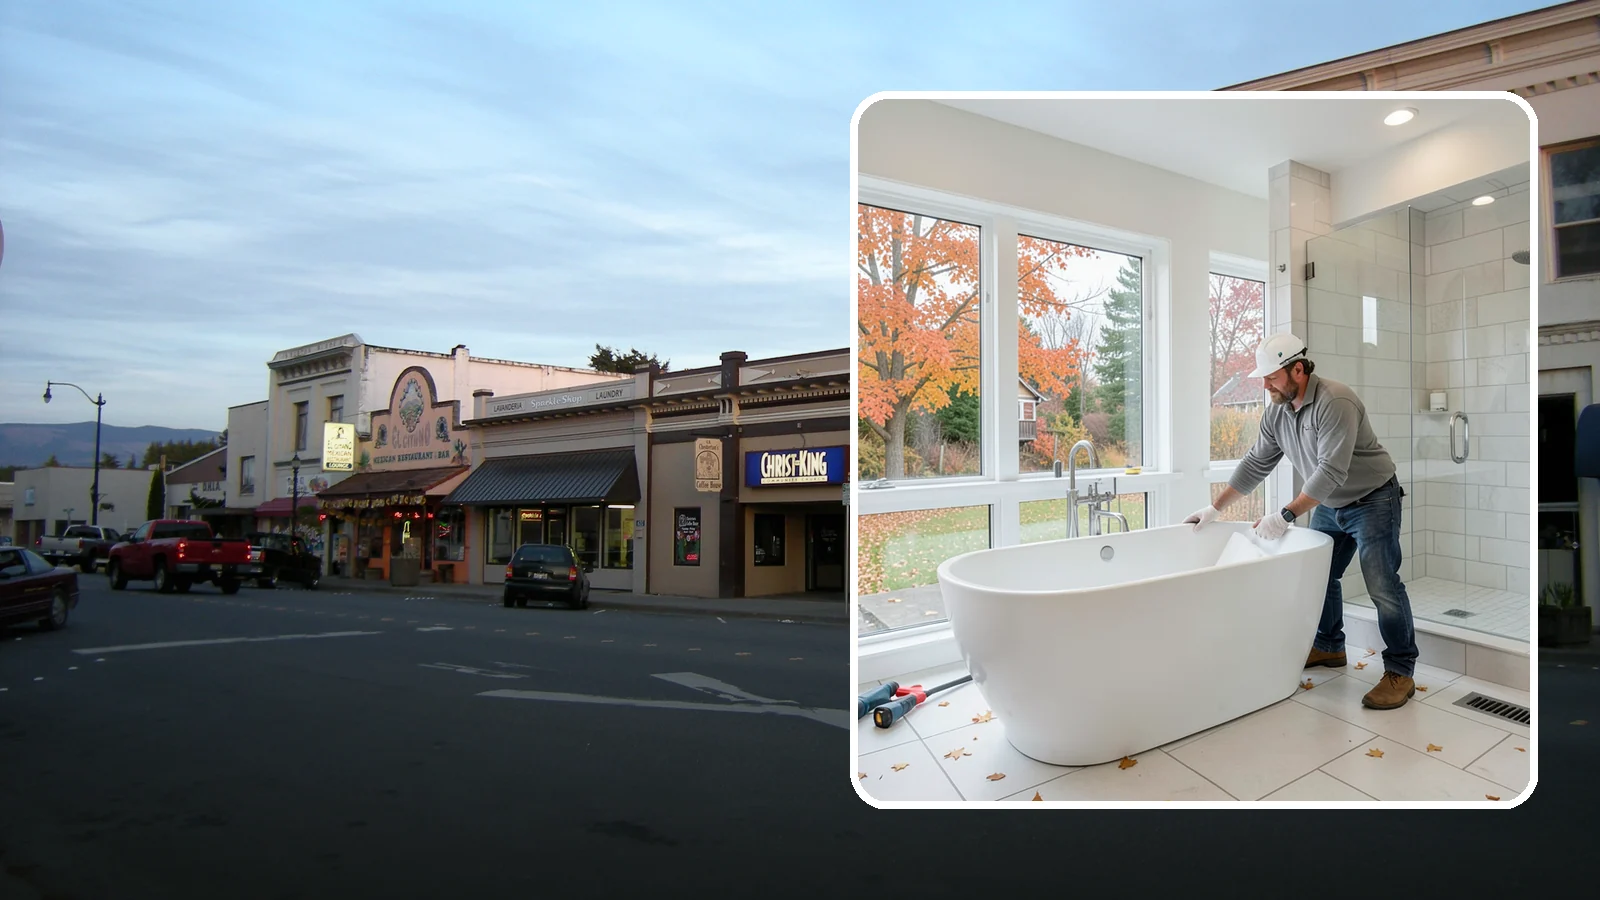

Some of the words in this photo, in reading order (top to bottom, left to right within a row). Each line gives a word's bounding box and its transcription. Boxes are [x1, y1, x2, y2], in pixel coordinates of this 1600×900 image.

[530, 398, 560, 408] Sparkle
[561, 394, 582, 404] Shop
[595, 388, 623, 400] LAUNDRY
[494, 402, 522, 412] LAVANDERIA
[374, 455, 396, 464] MEXICAN
[398, 452, 433, 462] RESTAURANT
[438, 450, 450, 458] BAR
[761, 452, 797, 478] CHRIST
[800, 450, 827, 476] KING
